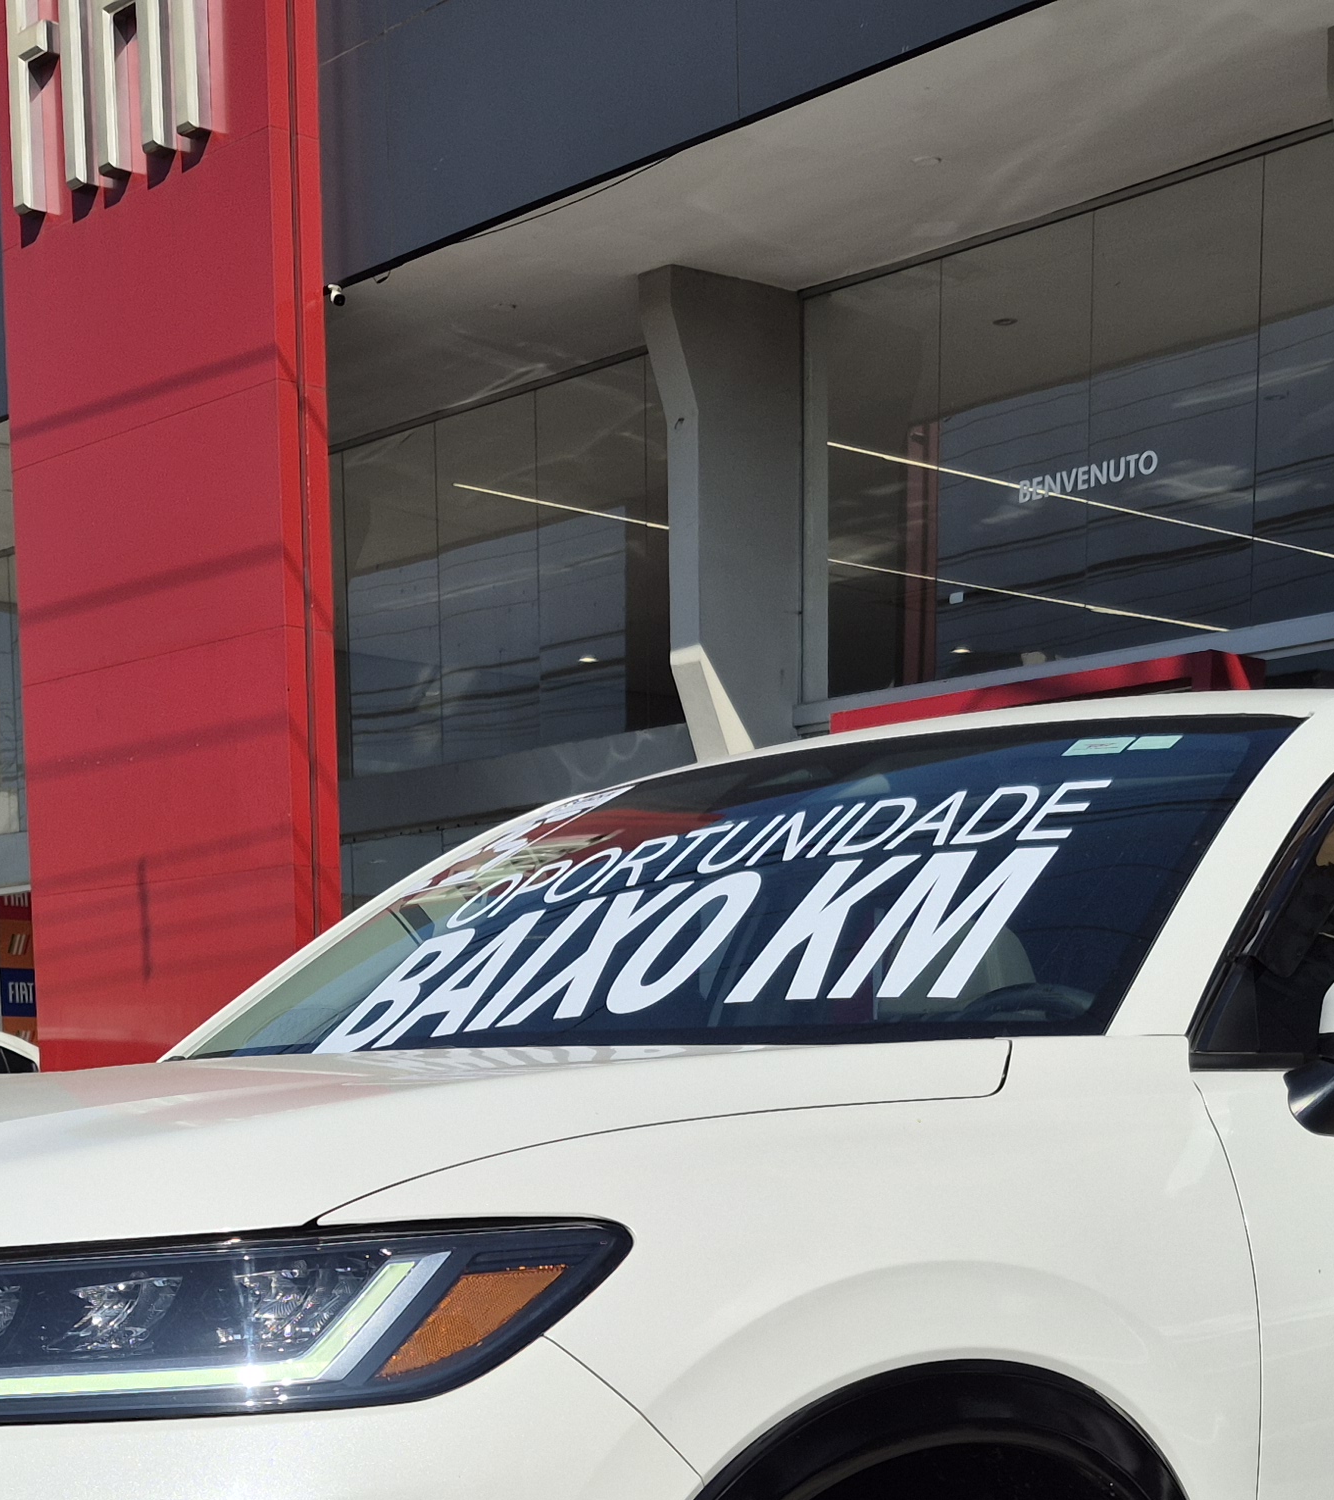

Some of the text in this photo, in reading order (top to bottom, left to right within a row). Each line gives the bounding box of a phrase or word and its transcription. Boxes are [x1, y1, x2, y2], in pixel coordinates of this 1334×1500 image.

[1017, 449, 1158, 503] BENVENUTO
[446, 779, 1112, 930] OPORTUNIDADE
[8, 981, 34, 1004] FIAT
[313, 846, 1058, 1054] BAIXO KM
